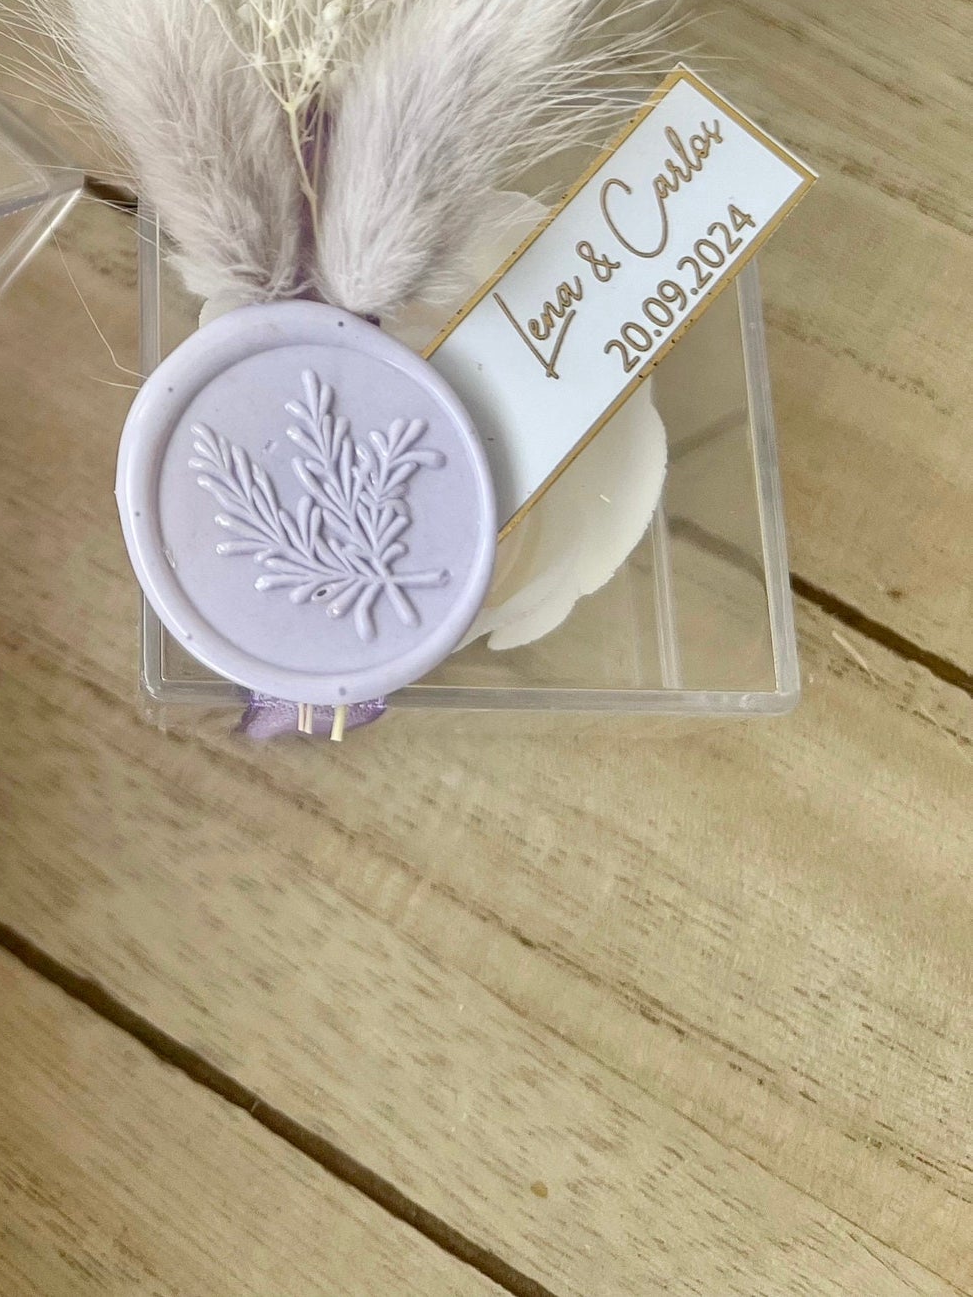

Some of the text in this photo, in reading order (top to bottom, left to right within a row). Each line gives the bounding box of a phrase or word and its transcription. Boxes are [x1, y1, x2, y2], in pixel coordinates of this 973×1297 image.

[492, 119, 723, 380] Lena & Carlos
[604, 203, 756, 373] 20.09.2024
